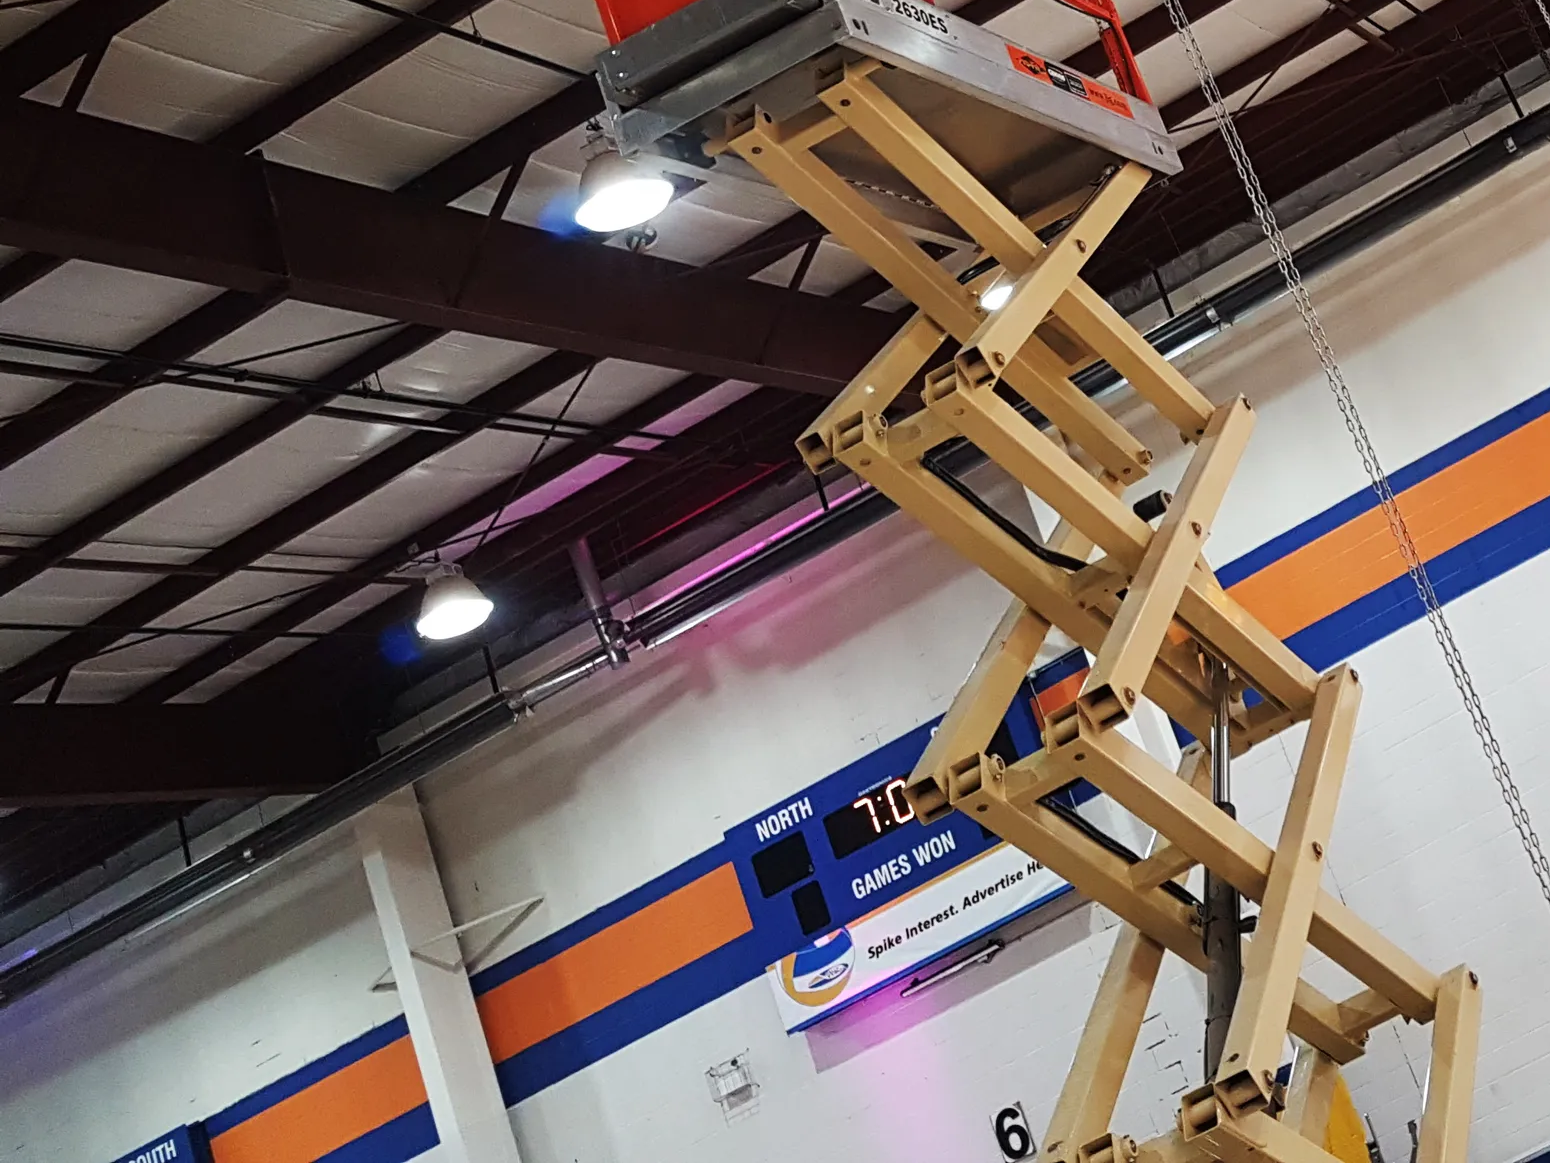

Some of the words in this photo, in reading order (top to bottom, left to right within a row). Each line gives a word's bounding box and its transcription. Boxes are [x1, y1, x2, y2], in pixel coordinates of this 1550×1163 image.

[755, 797, 813, 842] NORTH
[853, 779, 915, 833] 7:0
[851, 854, 912, 900] GAMES
[912, 830, 956, 867] WON
[867, 935, 902, 959] Spike
[905, 905, 959, 939] Interest.
[963, 872, 1024, 910] Advertise
[129, 1139, 177, 1163] UTH
[995, 1108, 1030, 1160] 6
